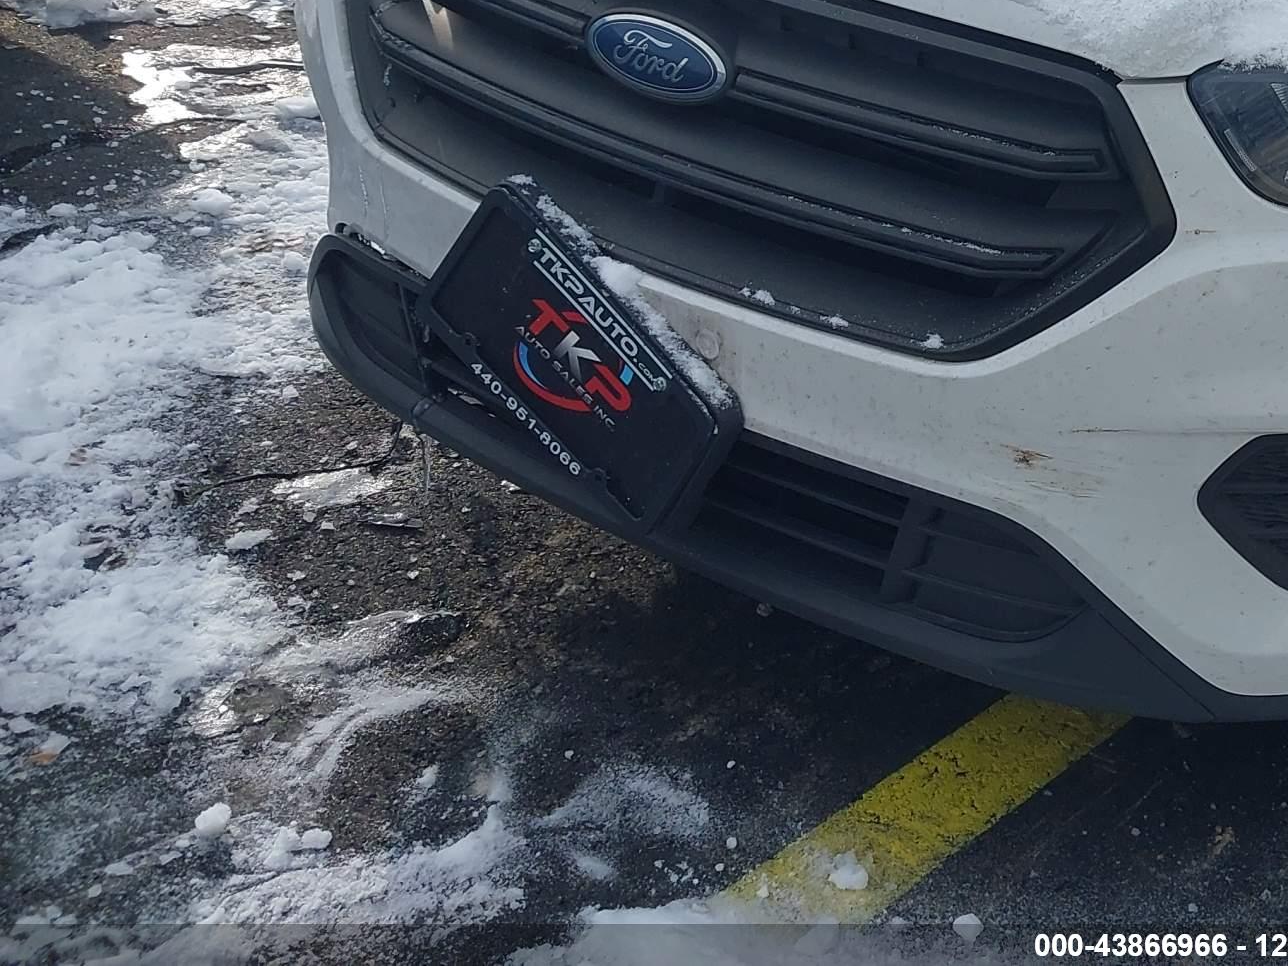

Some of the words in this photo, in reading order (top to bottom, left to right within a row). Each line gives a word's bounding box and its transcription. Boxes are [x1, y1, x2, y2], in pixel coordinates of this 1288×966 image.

[613, 29, 689, 82] Ford
[513, 325, 551, 361] AUTO
[551, 360, 594, 406] SALES
[528, 298, 632, 412] TKP
[470, 361, 581, 477] 440-951-8066
